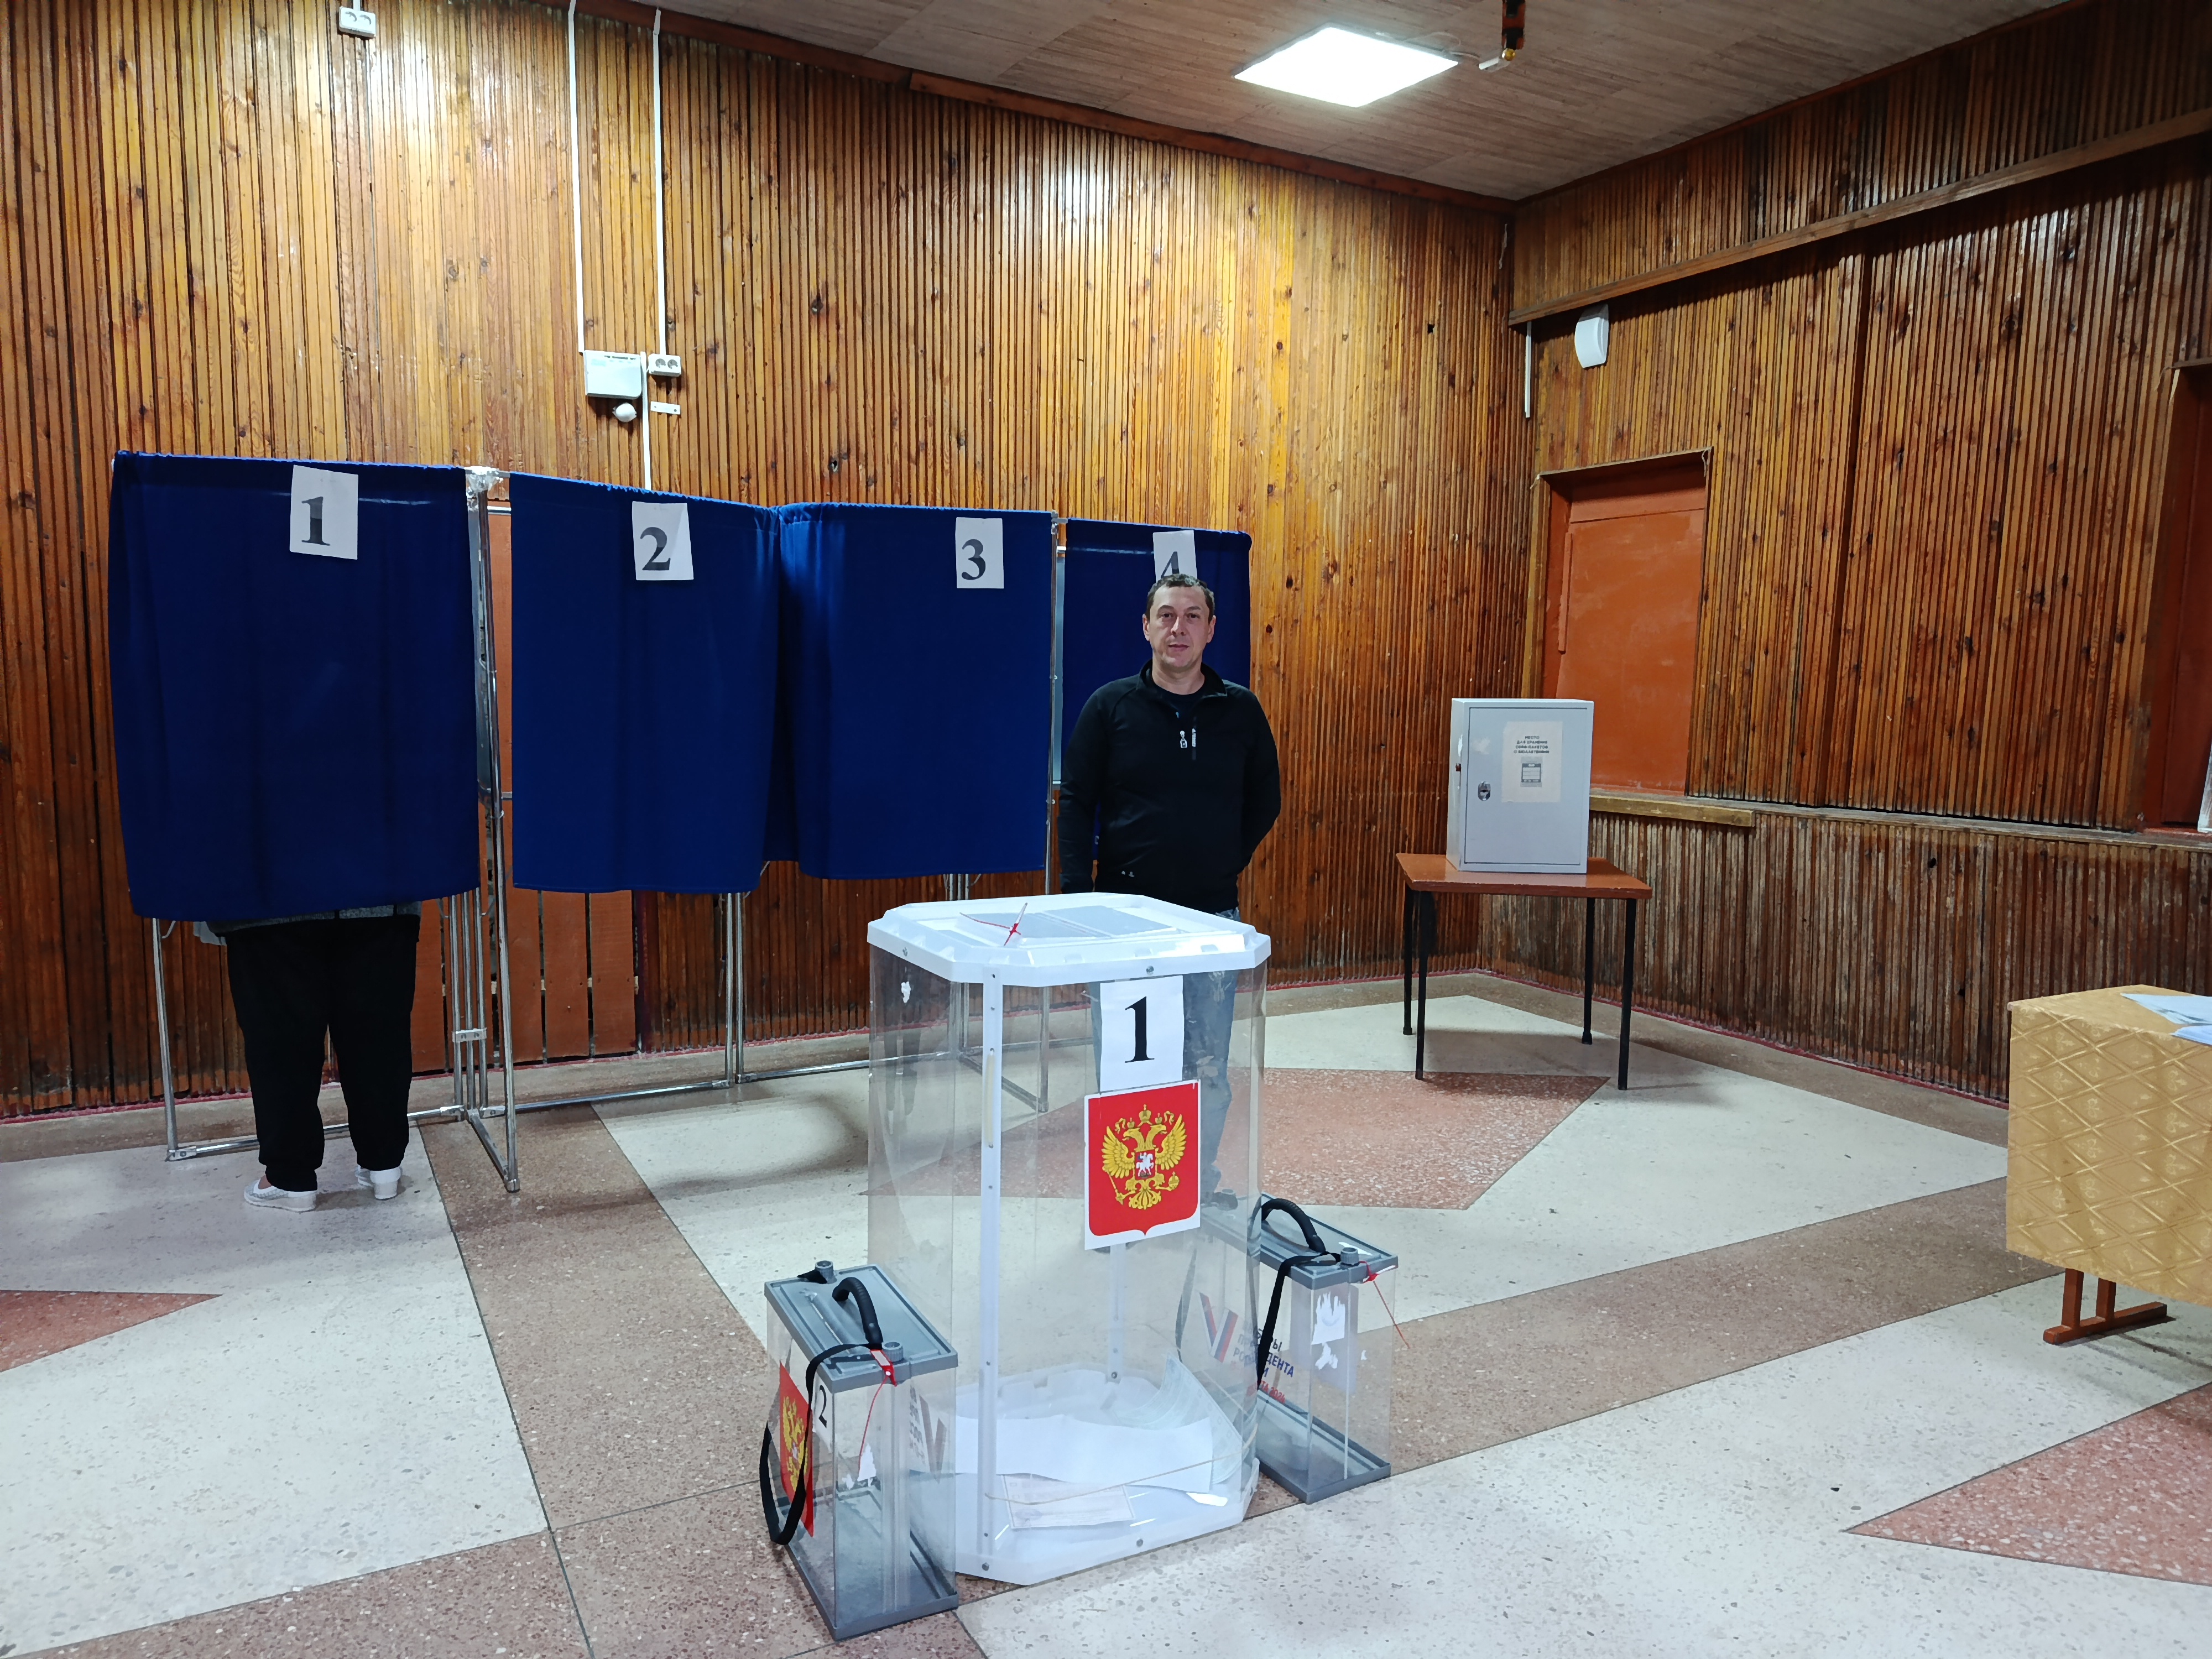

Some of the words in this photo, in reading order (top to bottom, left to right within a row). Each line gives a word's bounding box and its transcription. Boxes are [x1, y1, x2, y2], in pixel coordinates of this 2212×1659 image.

[301, 496, 331, 546] 1
[640, 526, 671, 571] 2
[961, 539, 986, 580] 3
[1124, 996, 1155, 1063] 1
[818, 1384, 827, 1428] 2
